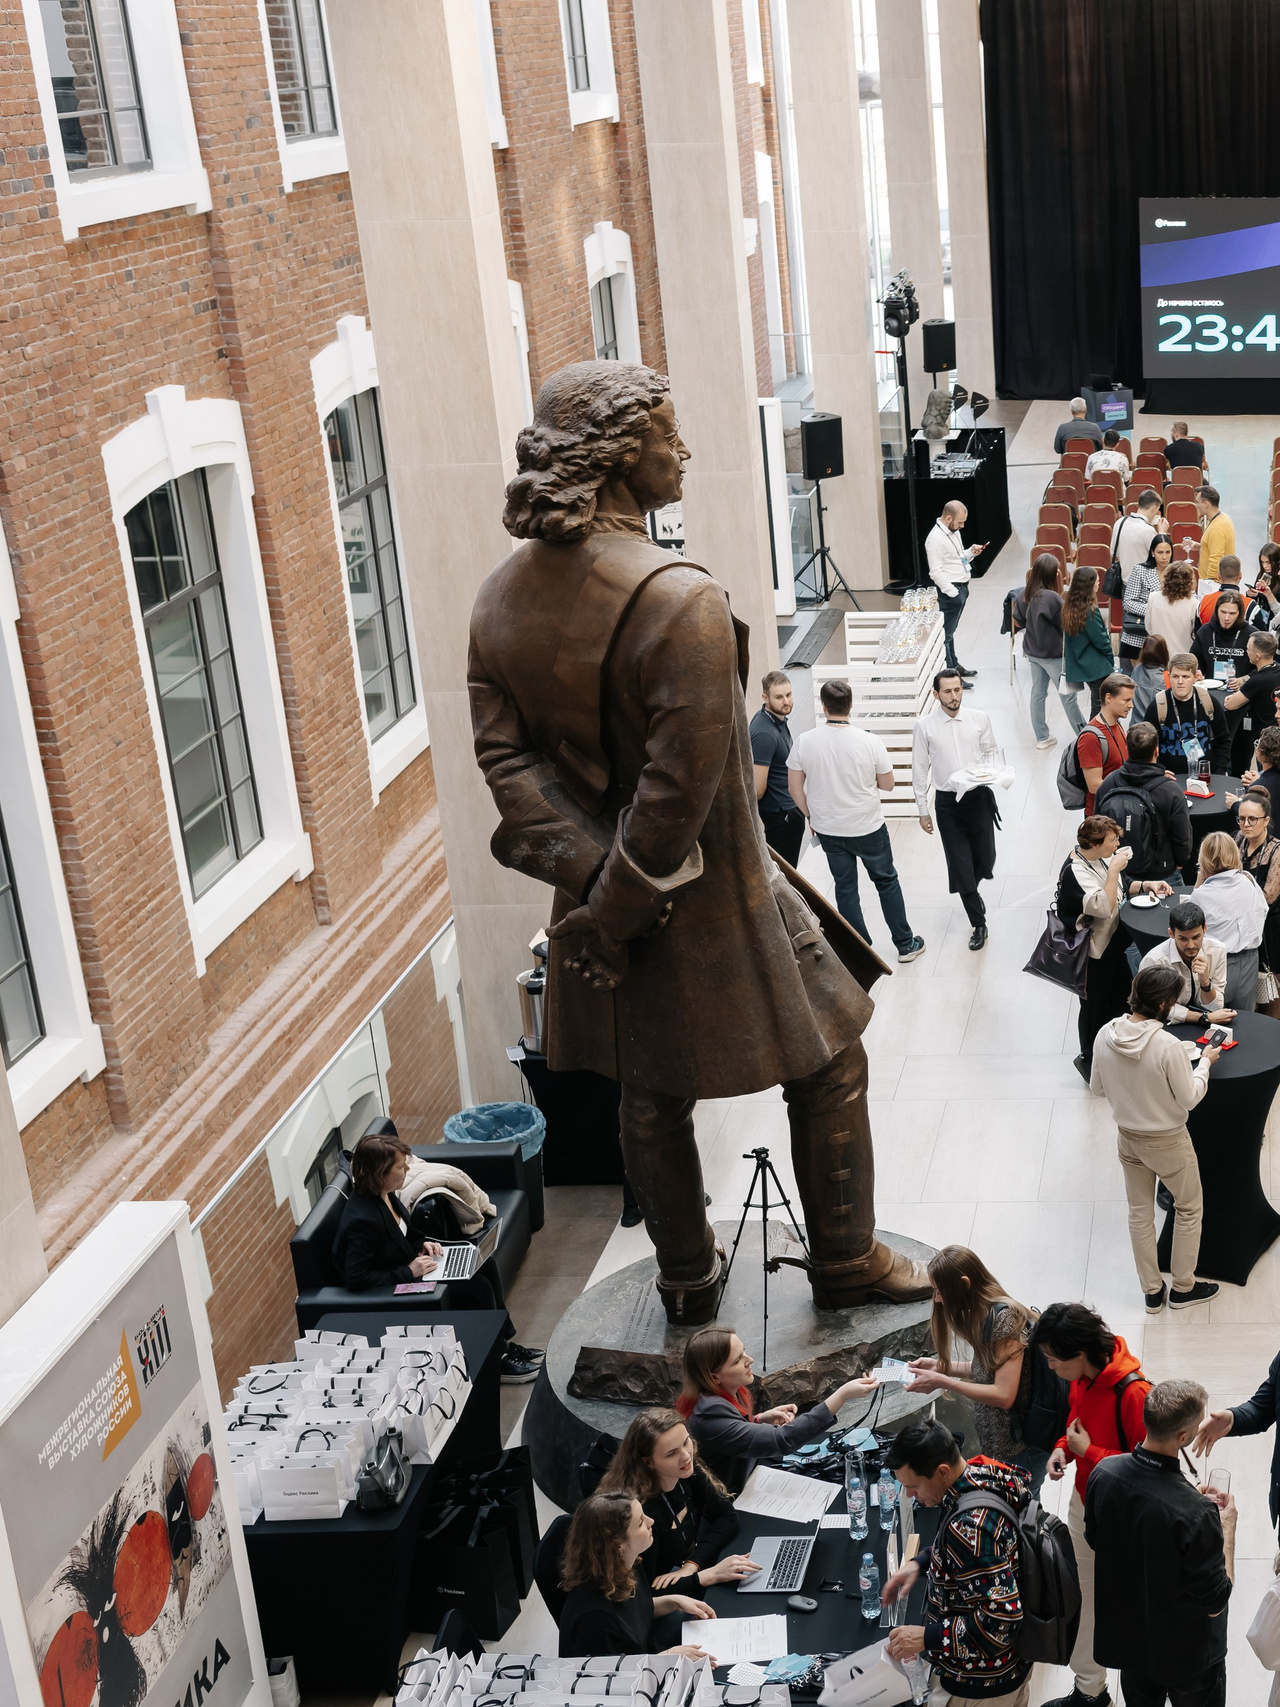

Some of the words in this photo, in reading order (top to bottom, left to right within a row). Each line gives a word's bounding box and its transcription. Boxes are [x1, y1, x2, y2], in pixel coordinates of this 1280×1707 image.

[1157, 299, 1168, 308] До
[38, 1354, 123, 1464] МЕЖРЕГИОНАЛЬНАЯ
[48, 1409, 96, 1470] ВЫСТАВКА
[95, 1370, 128, 1412] СОЮЗА
[69, 1383, 130, 1462] ХУДОЖНИКОВ
[97, 1397, 133, 1447] РОССИИ
